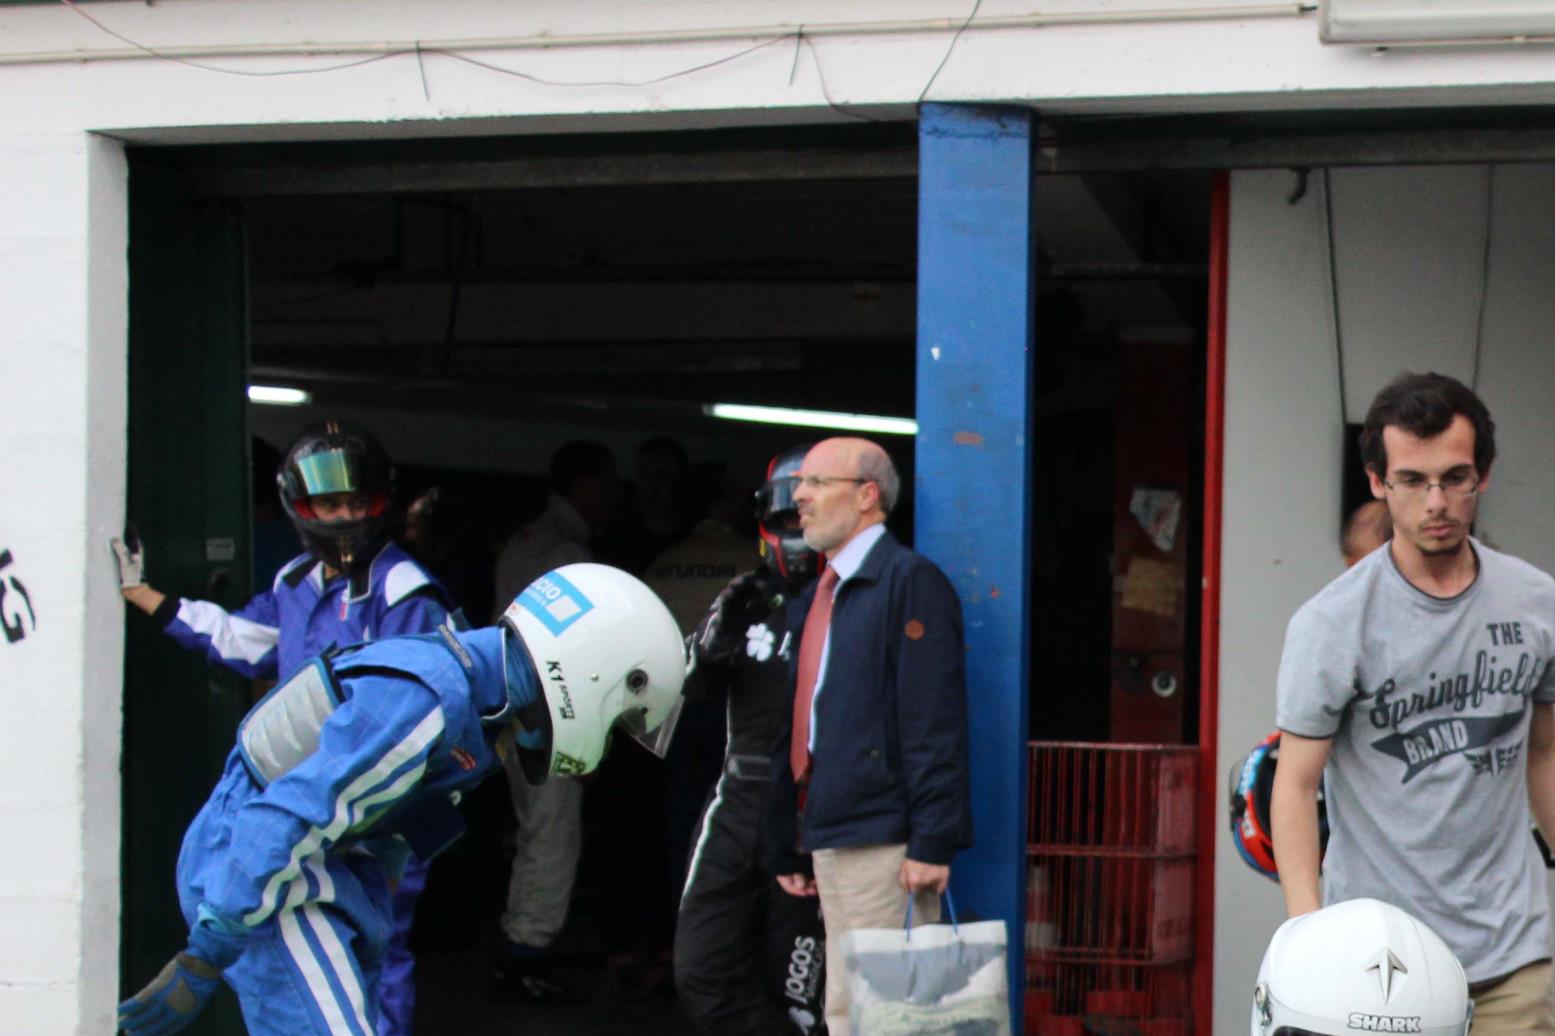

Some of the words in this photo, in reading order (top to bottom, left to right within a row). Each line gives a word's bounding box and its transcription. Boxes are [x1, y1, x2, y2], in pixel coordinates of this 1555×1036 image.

[1487, 622, 1523, 646] THE
[1403, 720, 1469, 765] BRAND
[1346, 1012, 1422, 1034] SHARK
